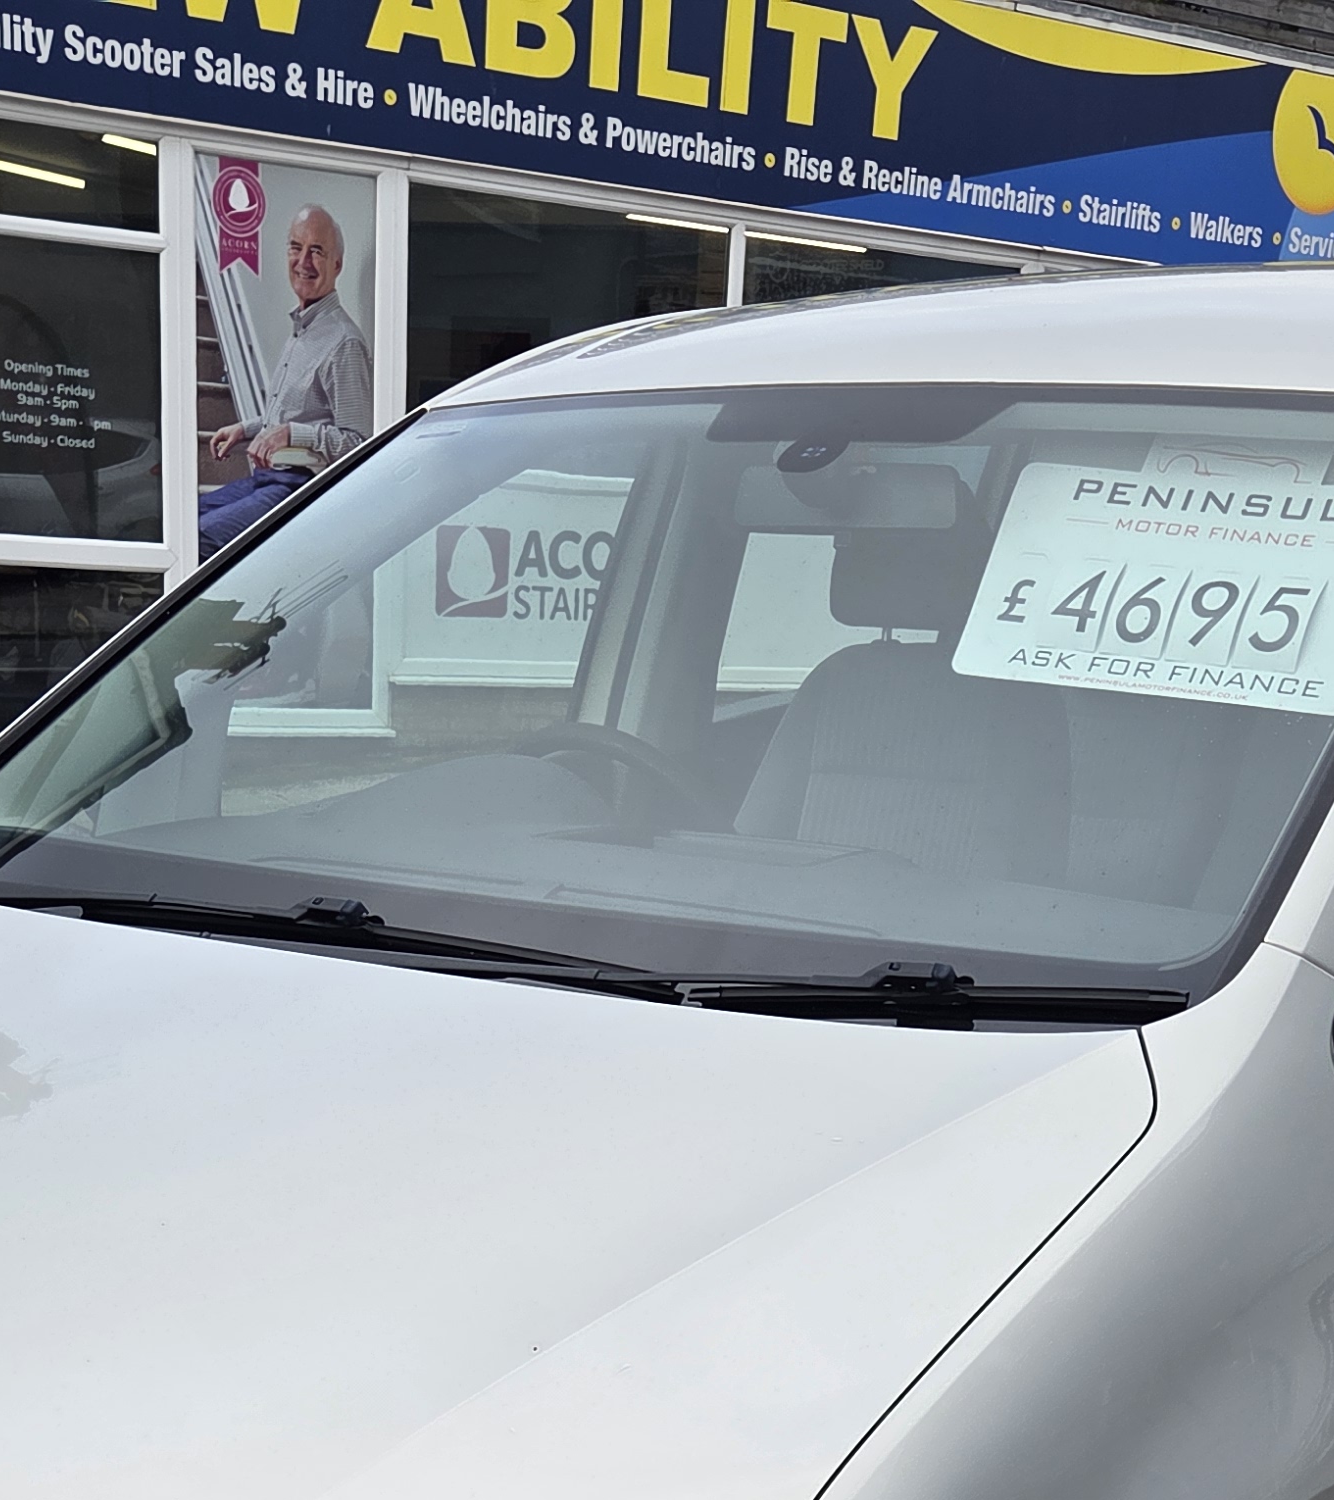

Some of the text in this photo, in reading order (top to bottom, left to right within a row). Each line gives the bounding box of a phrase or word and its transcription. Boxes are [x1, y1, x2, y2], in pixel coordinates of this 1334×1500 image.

[64, 23, 187, 79] Scooter
[194, 45, 276, 95] Sales
[284, 62, 308, 98] &
[316, 67, 374, 109] Hire
[408, 82, 571, 142] Wheelchairs
[578, 112, 599, 146] &
[605, 116, 757, 172] Powerchairs
[783, 146, 833, 184] Rise
[838, 156, 856, 188] &
[862, 159, 943, 202] Recline
[946, 173, 1056, 218] Armchairs
[1078, 194, 1161, 234] Stairlifts
[1190, 211, 1263, 249] Walkers
[221, 238, 258, 251] ACORN
[4, 359, 90, 378] Opening Times
[0, 378, 48, 396] Monday
[56, 383, 96, 400] Friday
[17, 393, 44, 407] 9am
[52, 396, 79, 411] 5pm
[50, 414, 77, 427] 9am
[2, 431, 48, 448] Sunday
[56, 435, 96, 449] Closed
[1115, 517, 1317, 549] MOTOR FINANCE
[514, 529, 616, 582] ACO
[513, 585, 599, 622] STAIR
[1051, 569, 1311, 653] 4695
[1007, 648, 1325, 699] ASK FOR FINANCE
